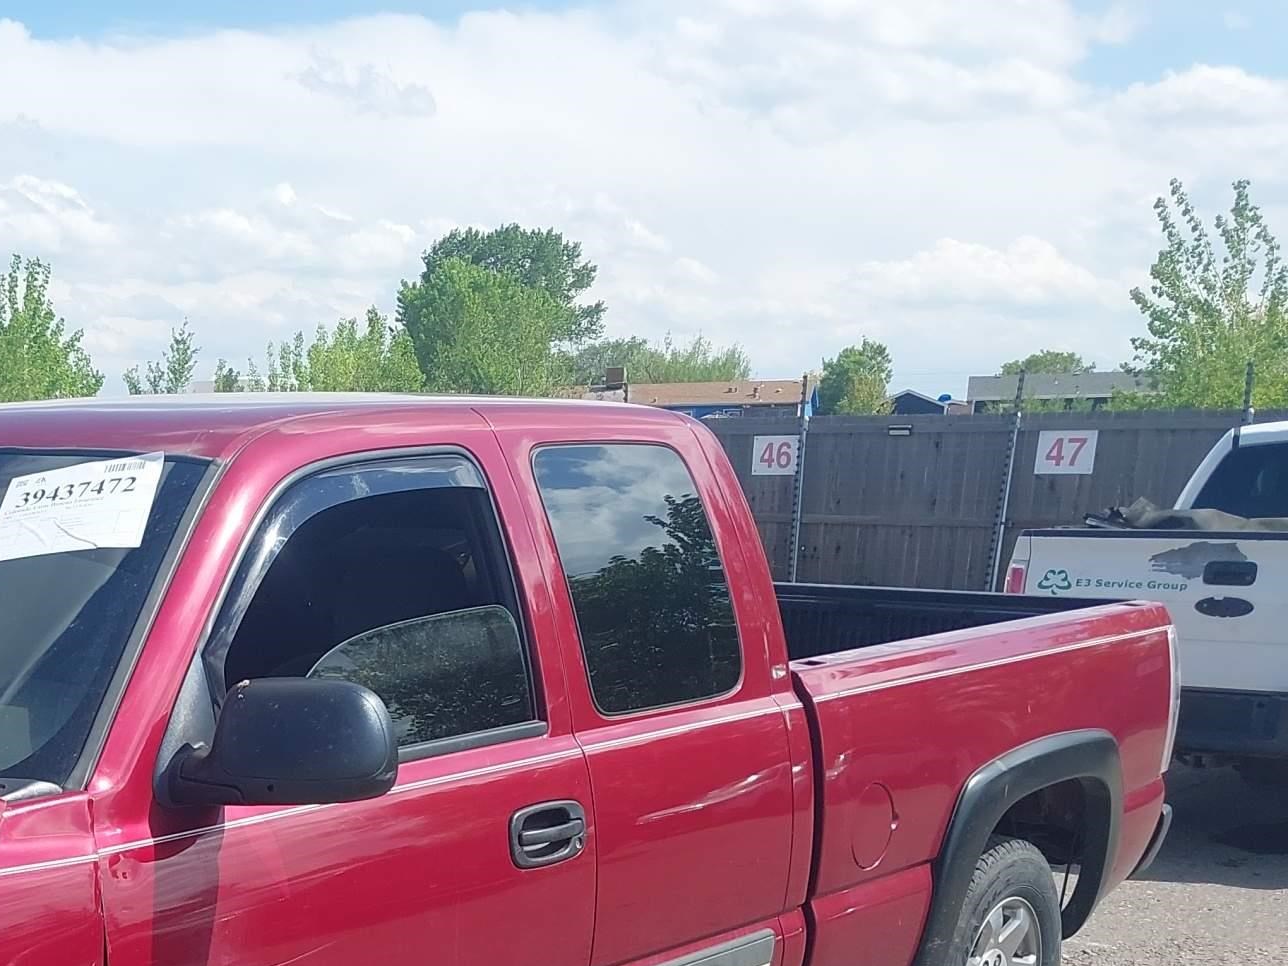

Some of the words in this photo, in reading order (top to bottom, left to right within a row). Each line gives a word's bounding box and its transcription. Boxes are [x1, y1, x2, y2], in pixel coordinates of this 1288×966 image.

[759, 441, 792, 469] 46
[1045, 437, 1088, 467] 47
[15, 476, 137, 508] 39437472
[1075, 578, 1091, 588] E3
[1095, 578, 1143, 589] Service
[1147, 579, 1188, 592] Group
